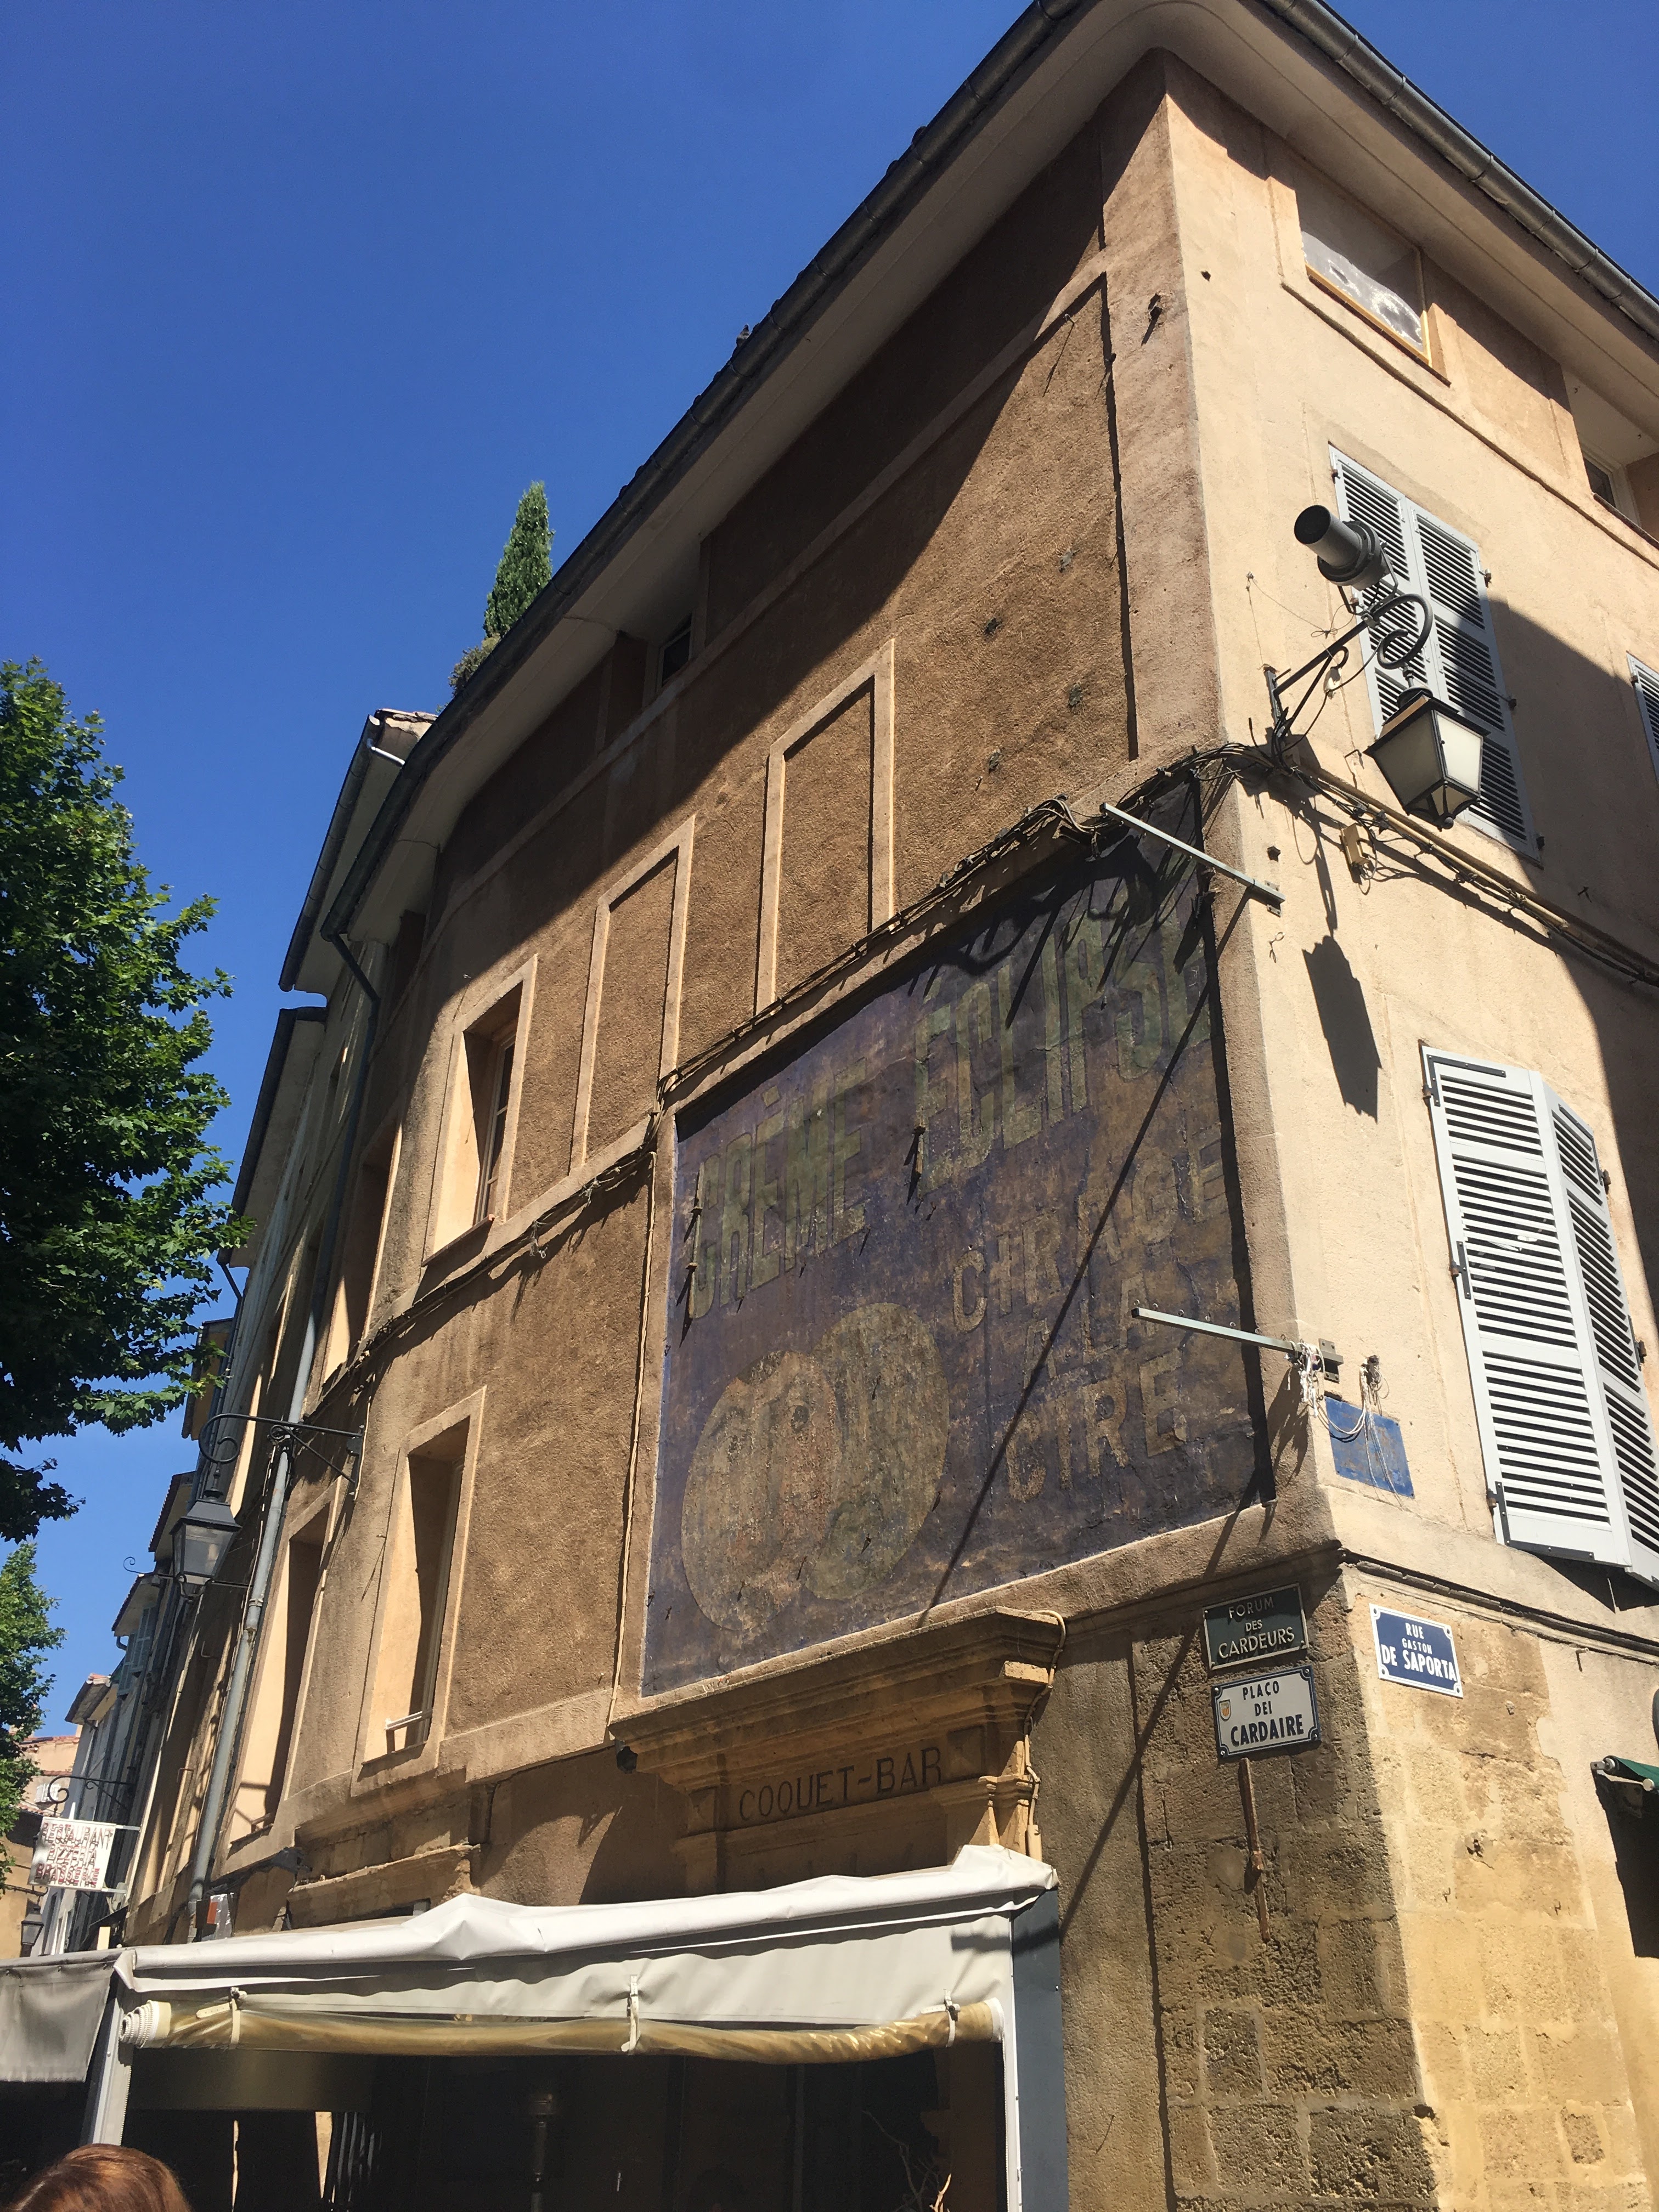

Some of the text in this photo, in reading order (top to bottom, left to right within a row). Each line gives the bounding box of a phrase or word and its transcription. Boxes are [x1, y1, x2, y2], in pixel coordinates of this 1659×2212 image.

[1228, 1596, 1274, 1619] FORUM
[1245, 1619, 1262, 1632] DES
[1405, 1622, 1423, 1639] RUE
[1218, 1627, 1295, 1659] CARDEURS
[1402, 1638, 1432, 1655] GASTON
[1381, 1644, 1457, 1681] DE SAPORTA
[1243, 1680, 1279, 1700] PLAÇO
[1255, 1700, 1272, 1716] DEI
[1231, 1714, 1304, 1747] CARDAIRE
[739, 1746, 941, 1821] COQUET-BAR
